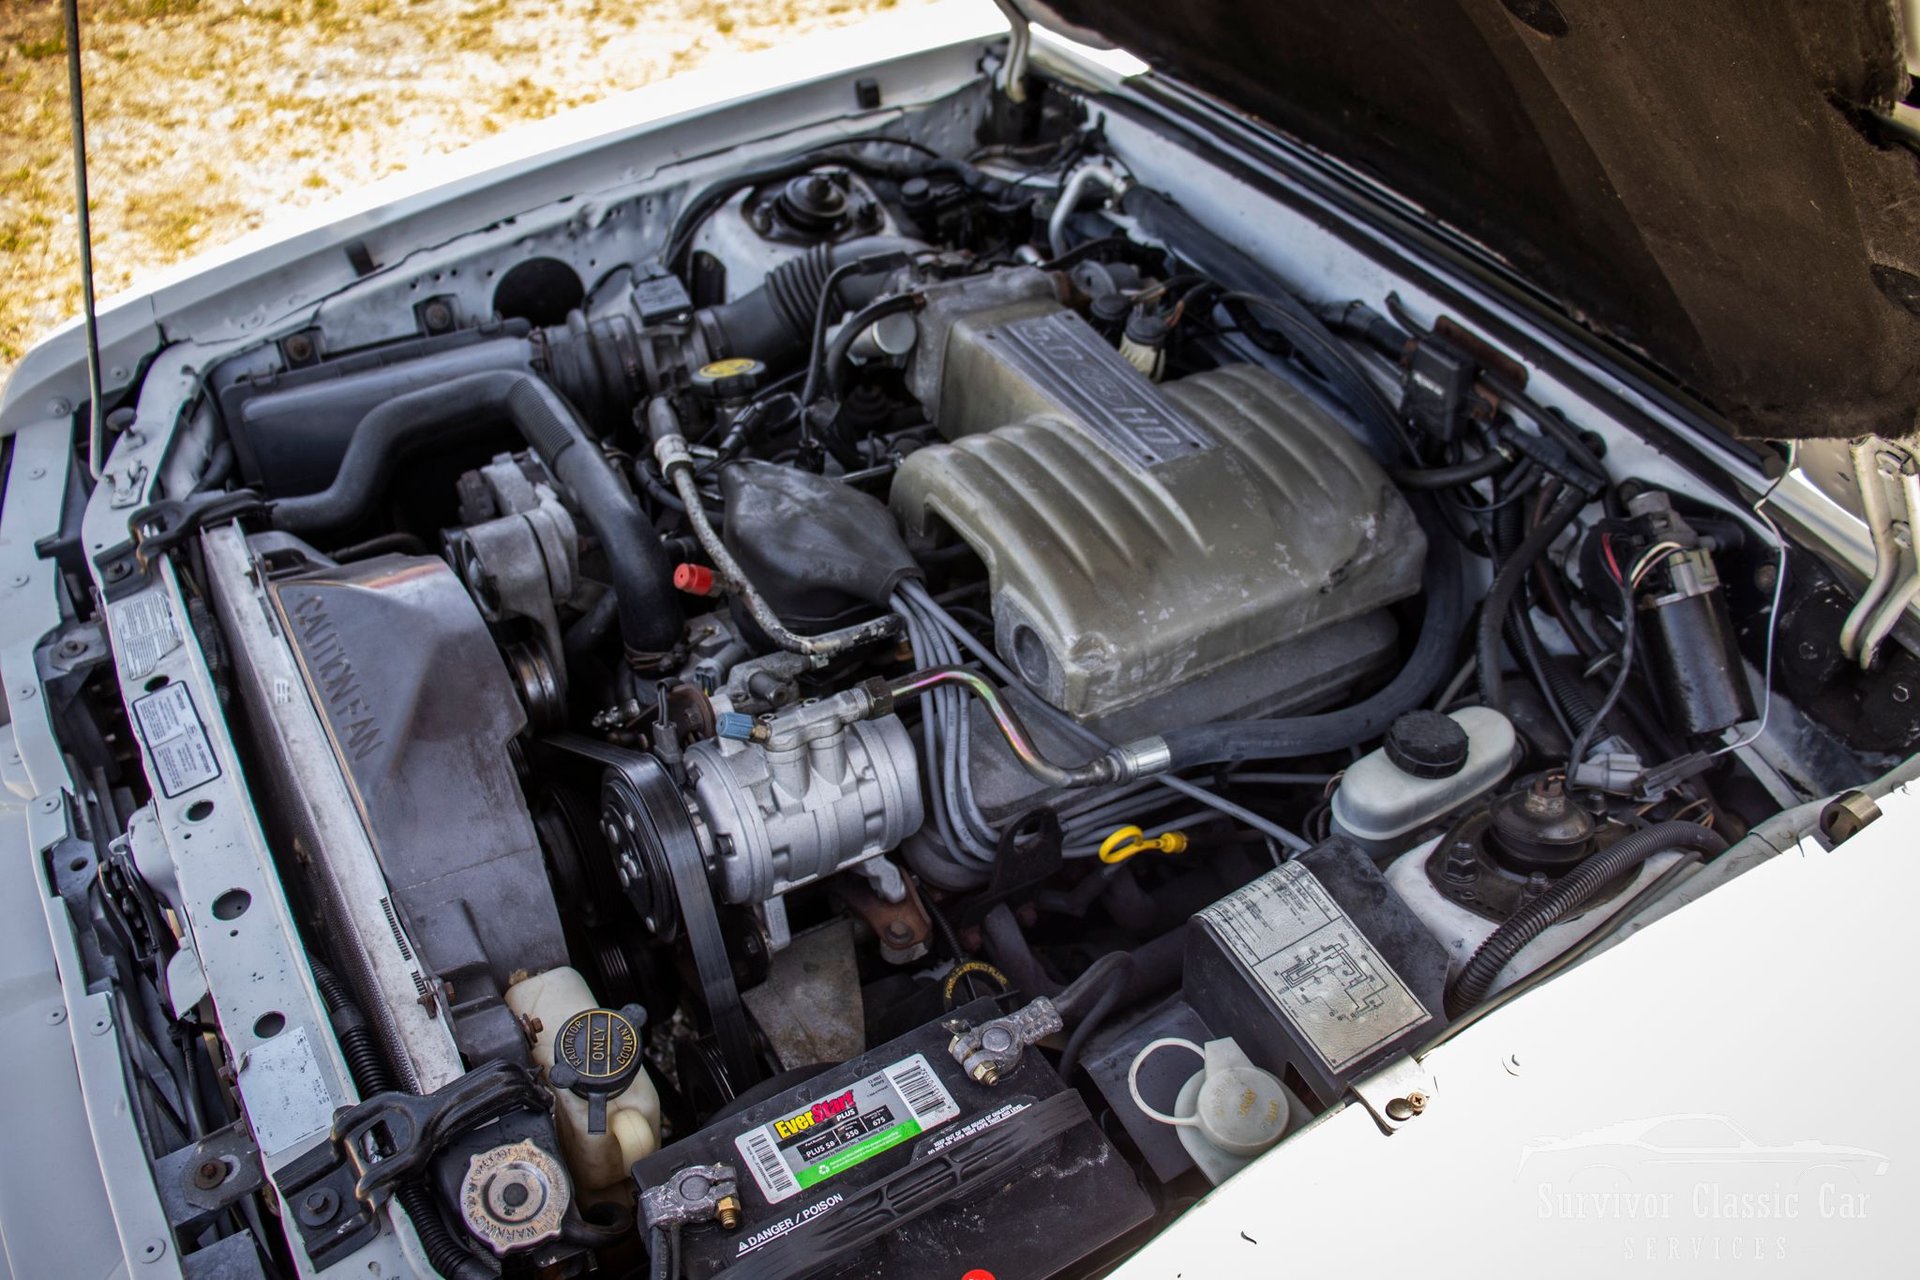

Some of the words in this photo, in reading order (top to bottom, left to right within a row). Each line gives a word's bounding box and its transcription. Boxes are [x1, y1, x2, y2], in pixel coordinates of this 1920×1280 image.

[295, 595, 360, 704] CAUTION
[336, 698, 384, 761] FAN
[563, 1020, 583, 1067] RADIATOR
[592, 1026, 606, 1061] ONLY
[616, 1023, 636, 1065] COOLANT
[775, 1089, 857, 1139] EverStart
[836, 1108, 856, 1122] PLUS
[871, 1116, 886, 1126] 675
[805, 1144, 825, 1158] PLUS
[844, 1128, 859, 1139] 550
[475, 1214, 538, 1240] WARNING
[747, 1216, 794, 1246] DANGER
[802, 1193, 843, 1218] POISON
